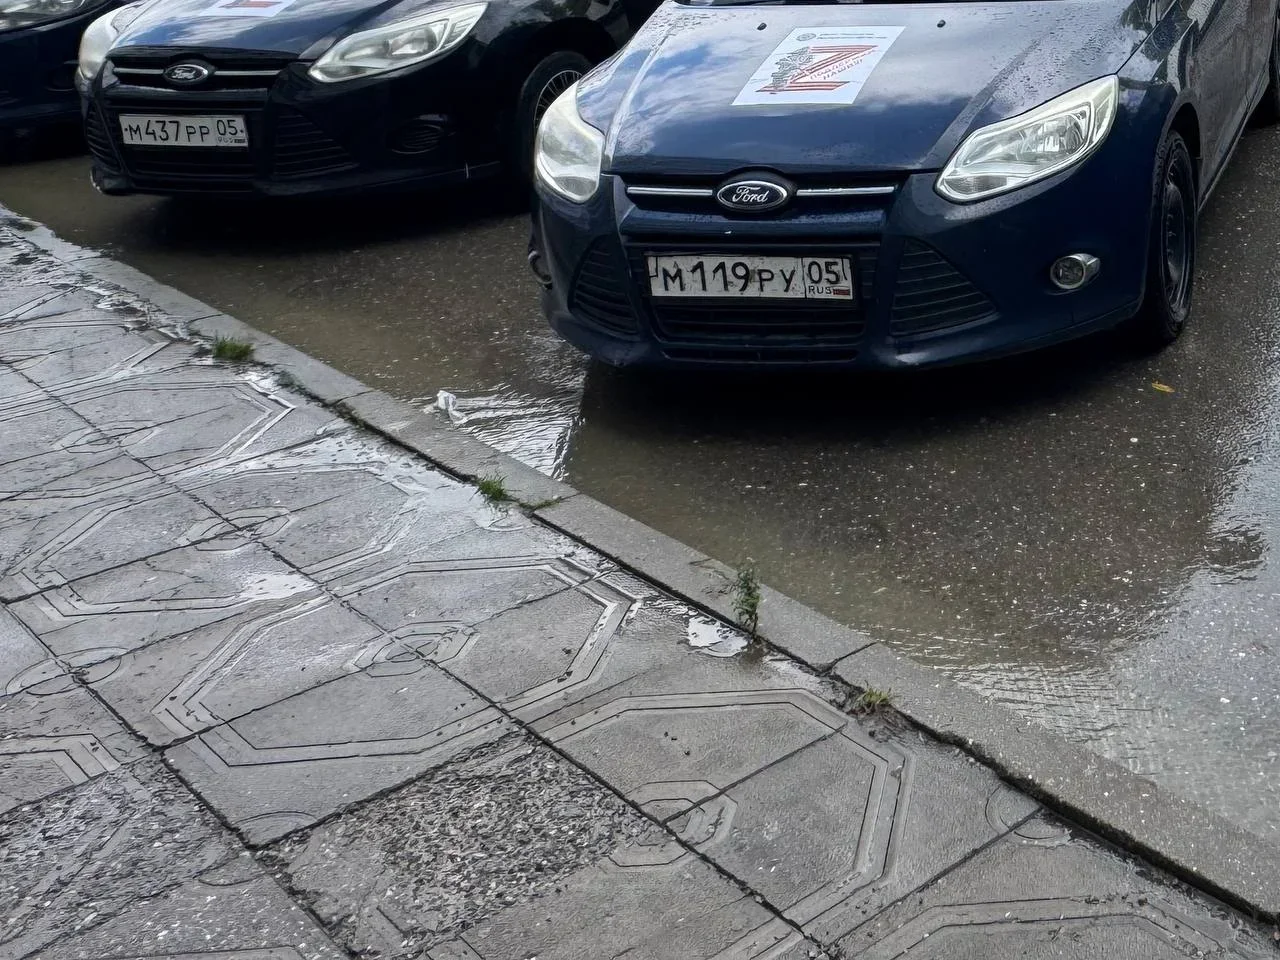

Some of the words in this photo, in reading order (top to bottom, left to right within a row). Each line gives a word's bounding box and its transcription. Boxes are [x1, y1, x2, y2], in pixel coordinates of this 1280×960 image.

[216, 119, 238, 137] 05
[732, 186, 768, 204] Ford
[807, 260, 840, 285] 05
[807, 285, 832, 296] RUS
